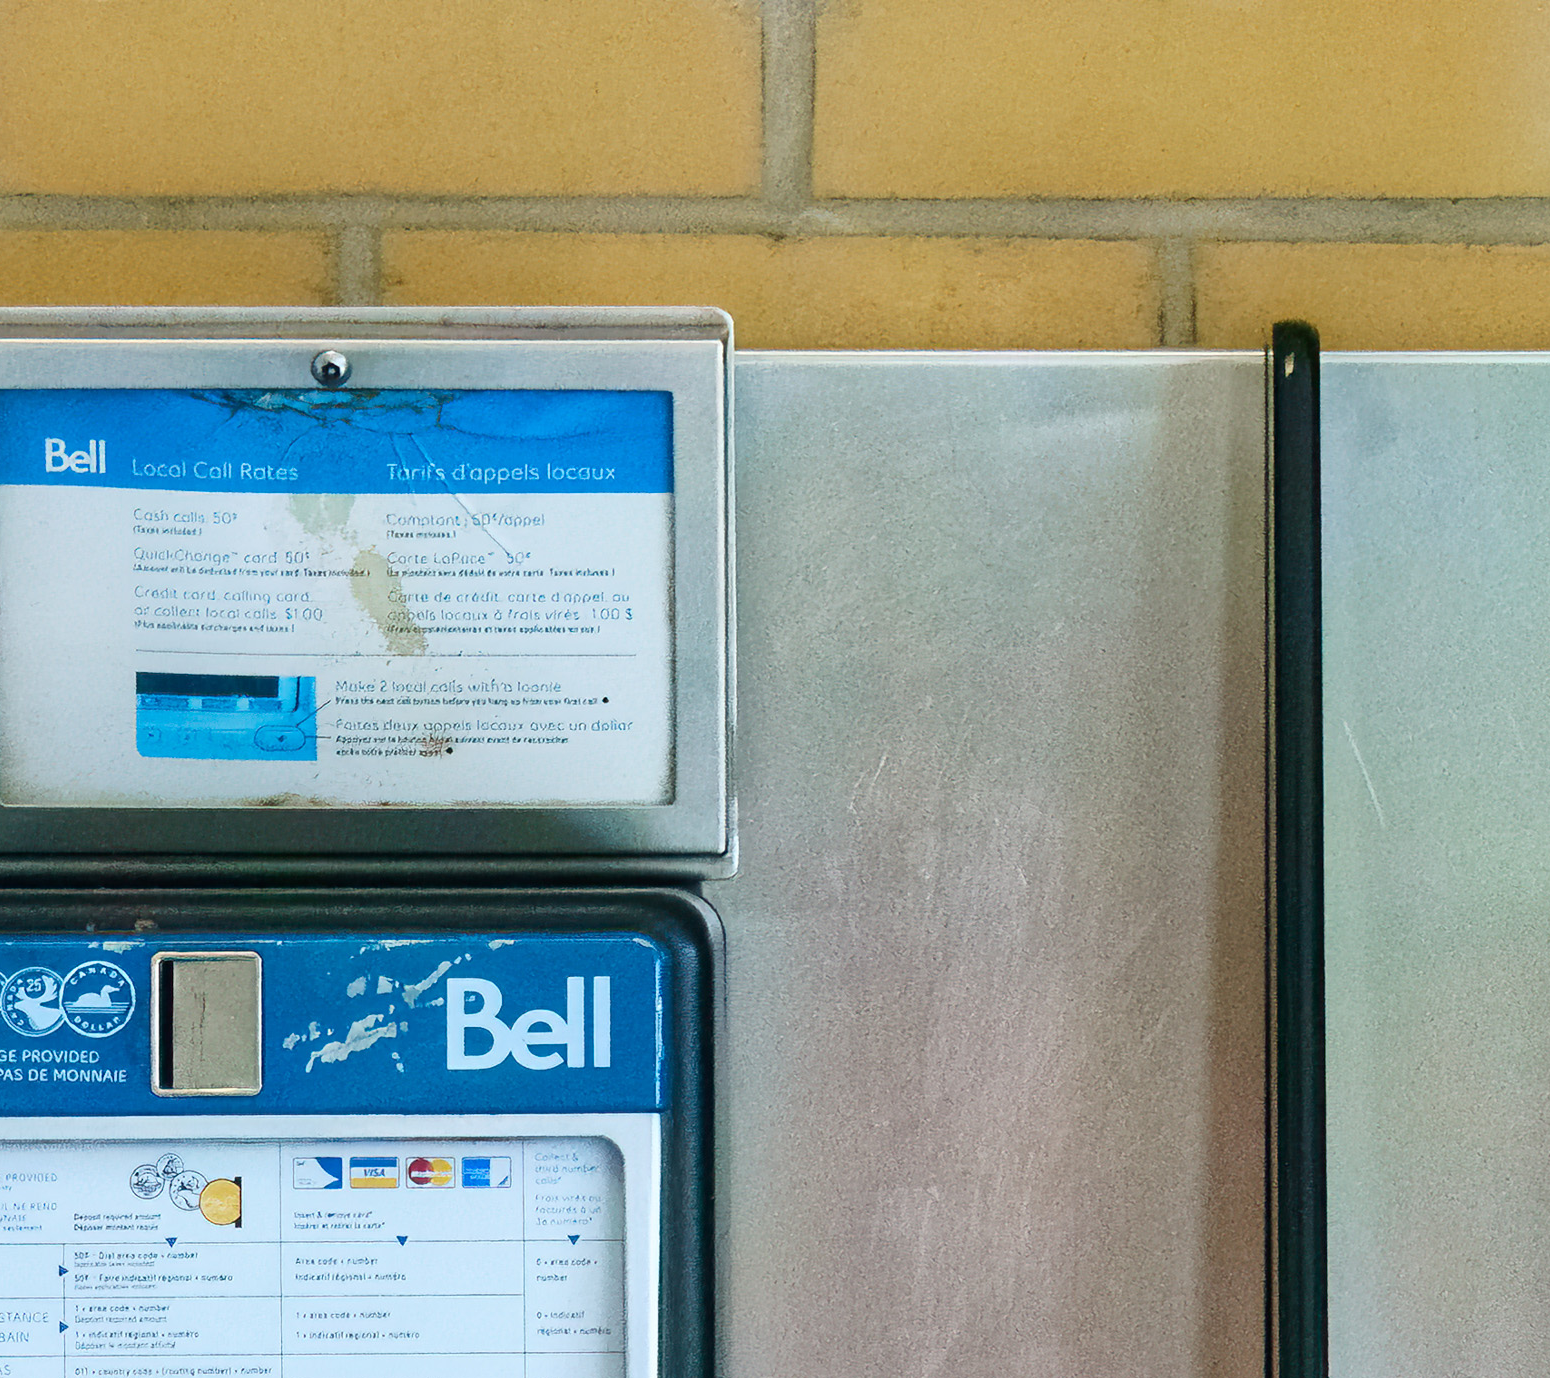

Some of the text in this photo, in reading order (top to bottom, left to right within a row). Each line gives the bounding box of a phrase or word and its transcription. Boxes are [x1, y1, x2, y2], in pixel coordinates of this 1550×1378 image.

[45, 437, 107, 475] Bell
[132, 458, 299, 480] Local Call Rates
[386, 463, 616, 484] Tarifs d'appels locaux
[133, 508, 169, 522] Cash
[244, 551, 278, 564] card
[387, 551, 427, 565] Carte
[223, 588, 271, 604] calling
[205, 606, 240, 619] local
[441, 608, 488, 621] locaux
[380, 681, 387, 692] 2
[468, 680, 501, 693] with
[517, 681, 562, 693] loonie
[476, 720, 525, 732] locaux
[530, 722, 564, 732] avec
[569, 722, 586, 732] un
[591, 719, 634, 732] dollar
[26, 978, 42, 992] 25
[446, 976, 612, 1071] Bell
[22, 1049, 100, 1063] PROVIDED
[28, 1069, 48, 1081] DE
[53, 1069, 127, 1083] MONNAIE
[362, 1168, 386, 1178] VISA
